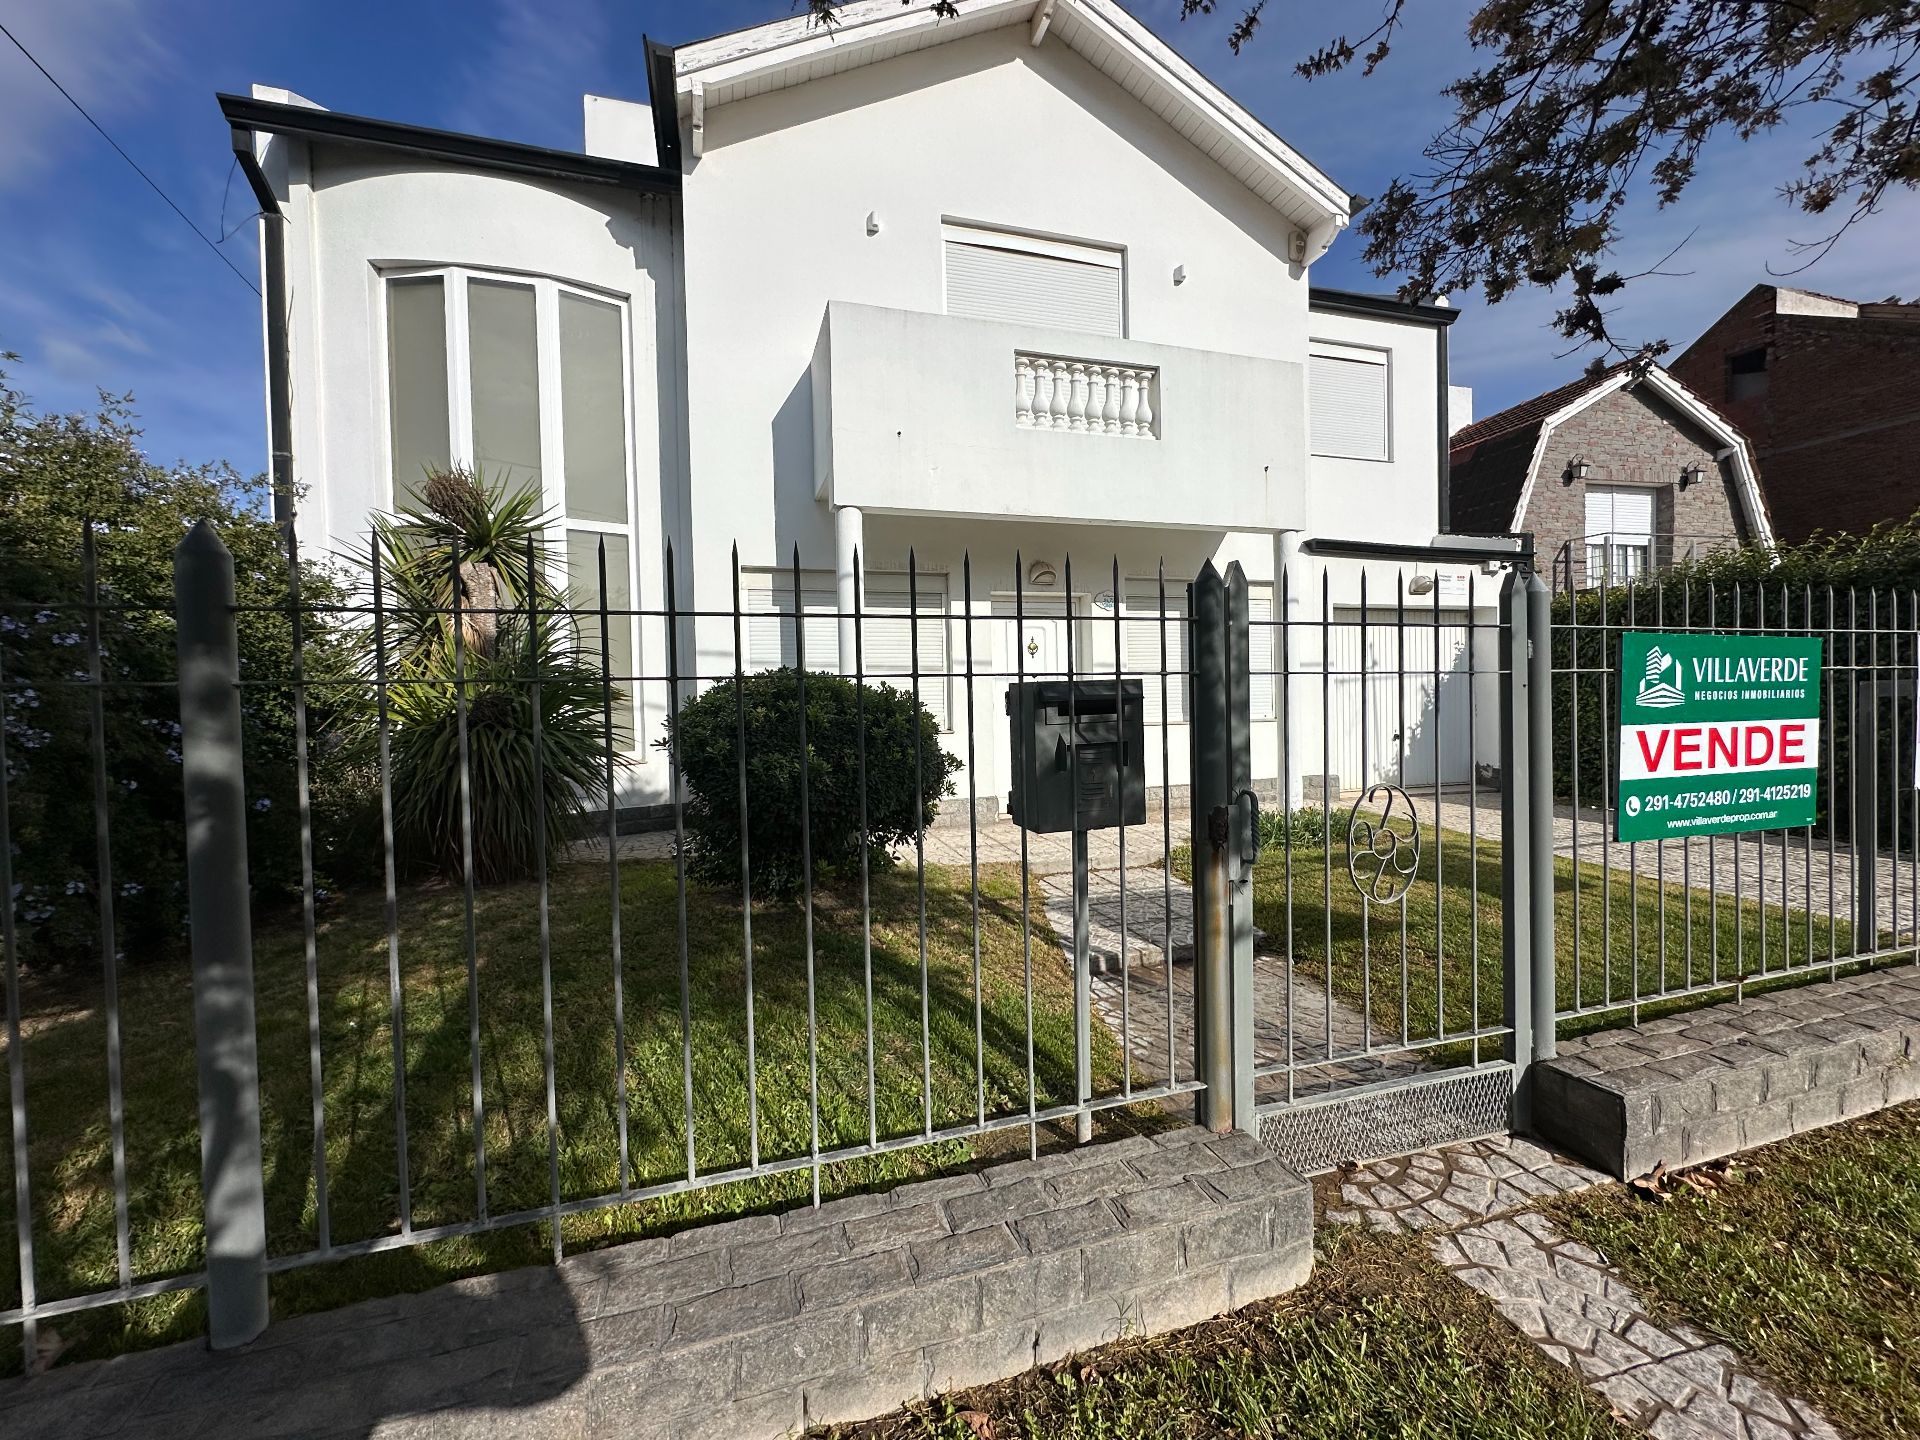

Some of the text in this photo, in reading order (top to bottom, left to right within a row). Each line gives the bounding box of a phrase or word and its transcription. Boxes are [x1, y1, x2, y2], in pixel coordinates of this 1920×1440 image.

[1692, 657, 1809, 684] VILLAVERDE
[1694, 689, 1806, 701] NEGOCIOS INMOBILIARIOS
[1636, 724, 1806, 773] VENDE
[1644, 789, 1731, 812] 291-4752480
[1739, 783, 1811, 804] 291-4125219
[1667, 810, 1778, 829] www.villaverdeprop.com.ar
